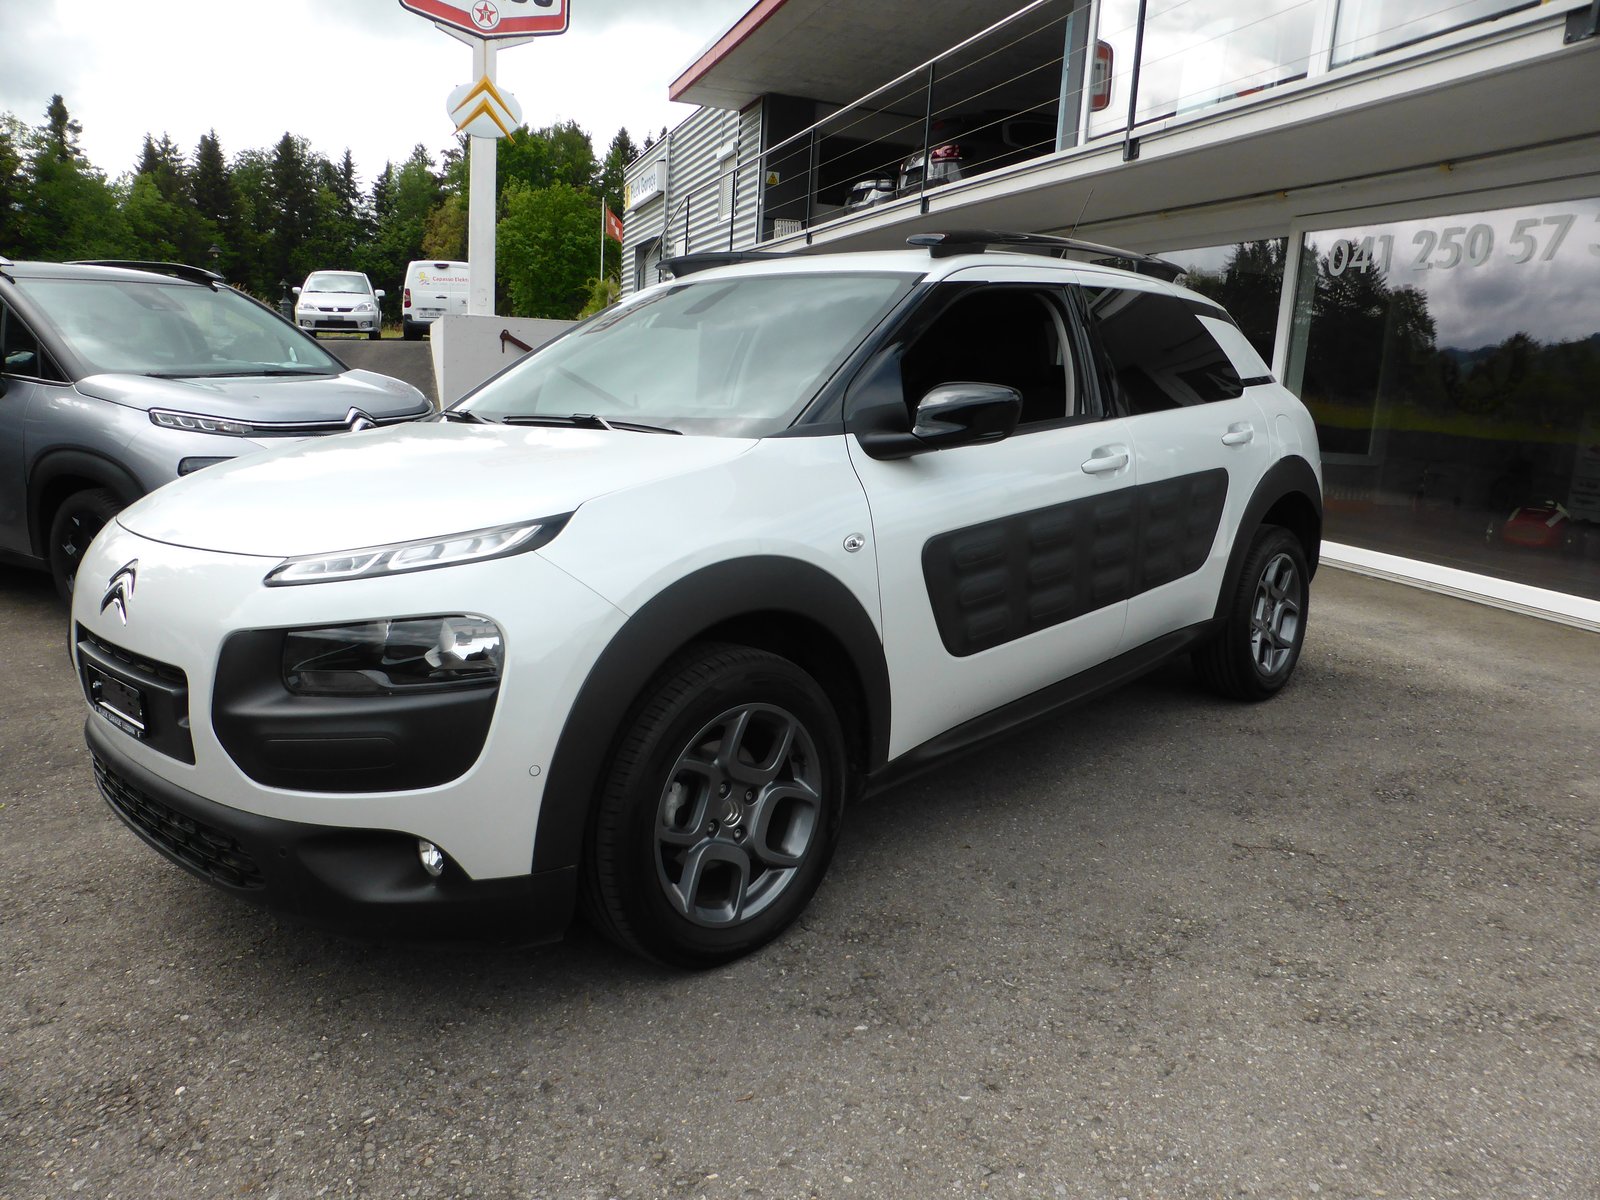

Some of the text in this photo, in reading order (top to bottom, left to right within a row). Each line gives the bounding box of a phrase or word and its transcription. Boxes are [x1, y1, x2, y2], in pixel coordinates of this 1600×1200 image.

[1327, 234, 1395, 277] 041
[1410, 223, 1495, 272] 250
[1506, 213, 1578, 264] 57
